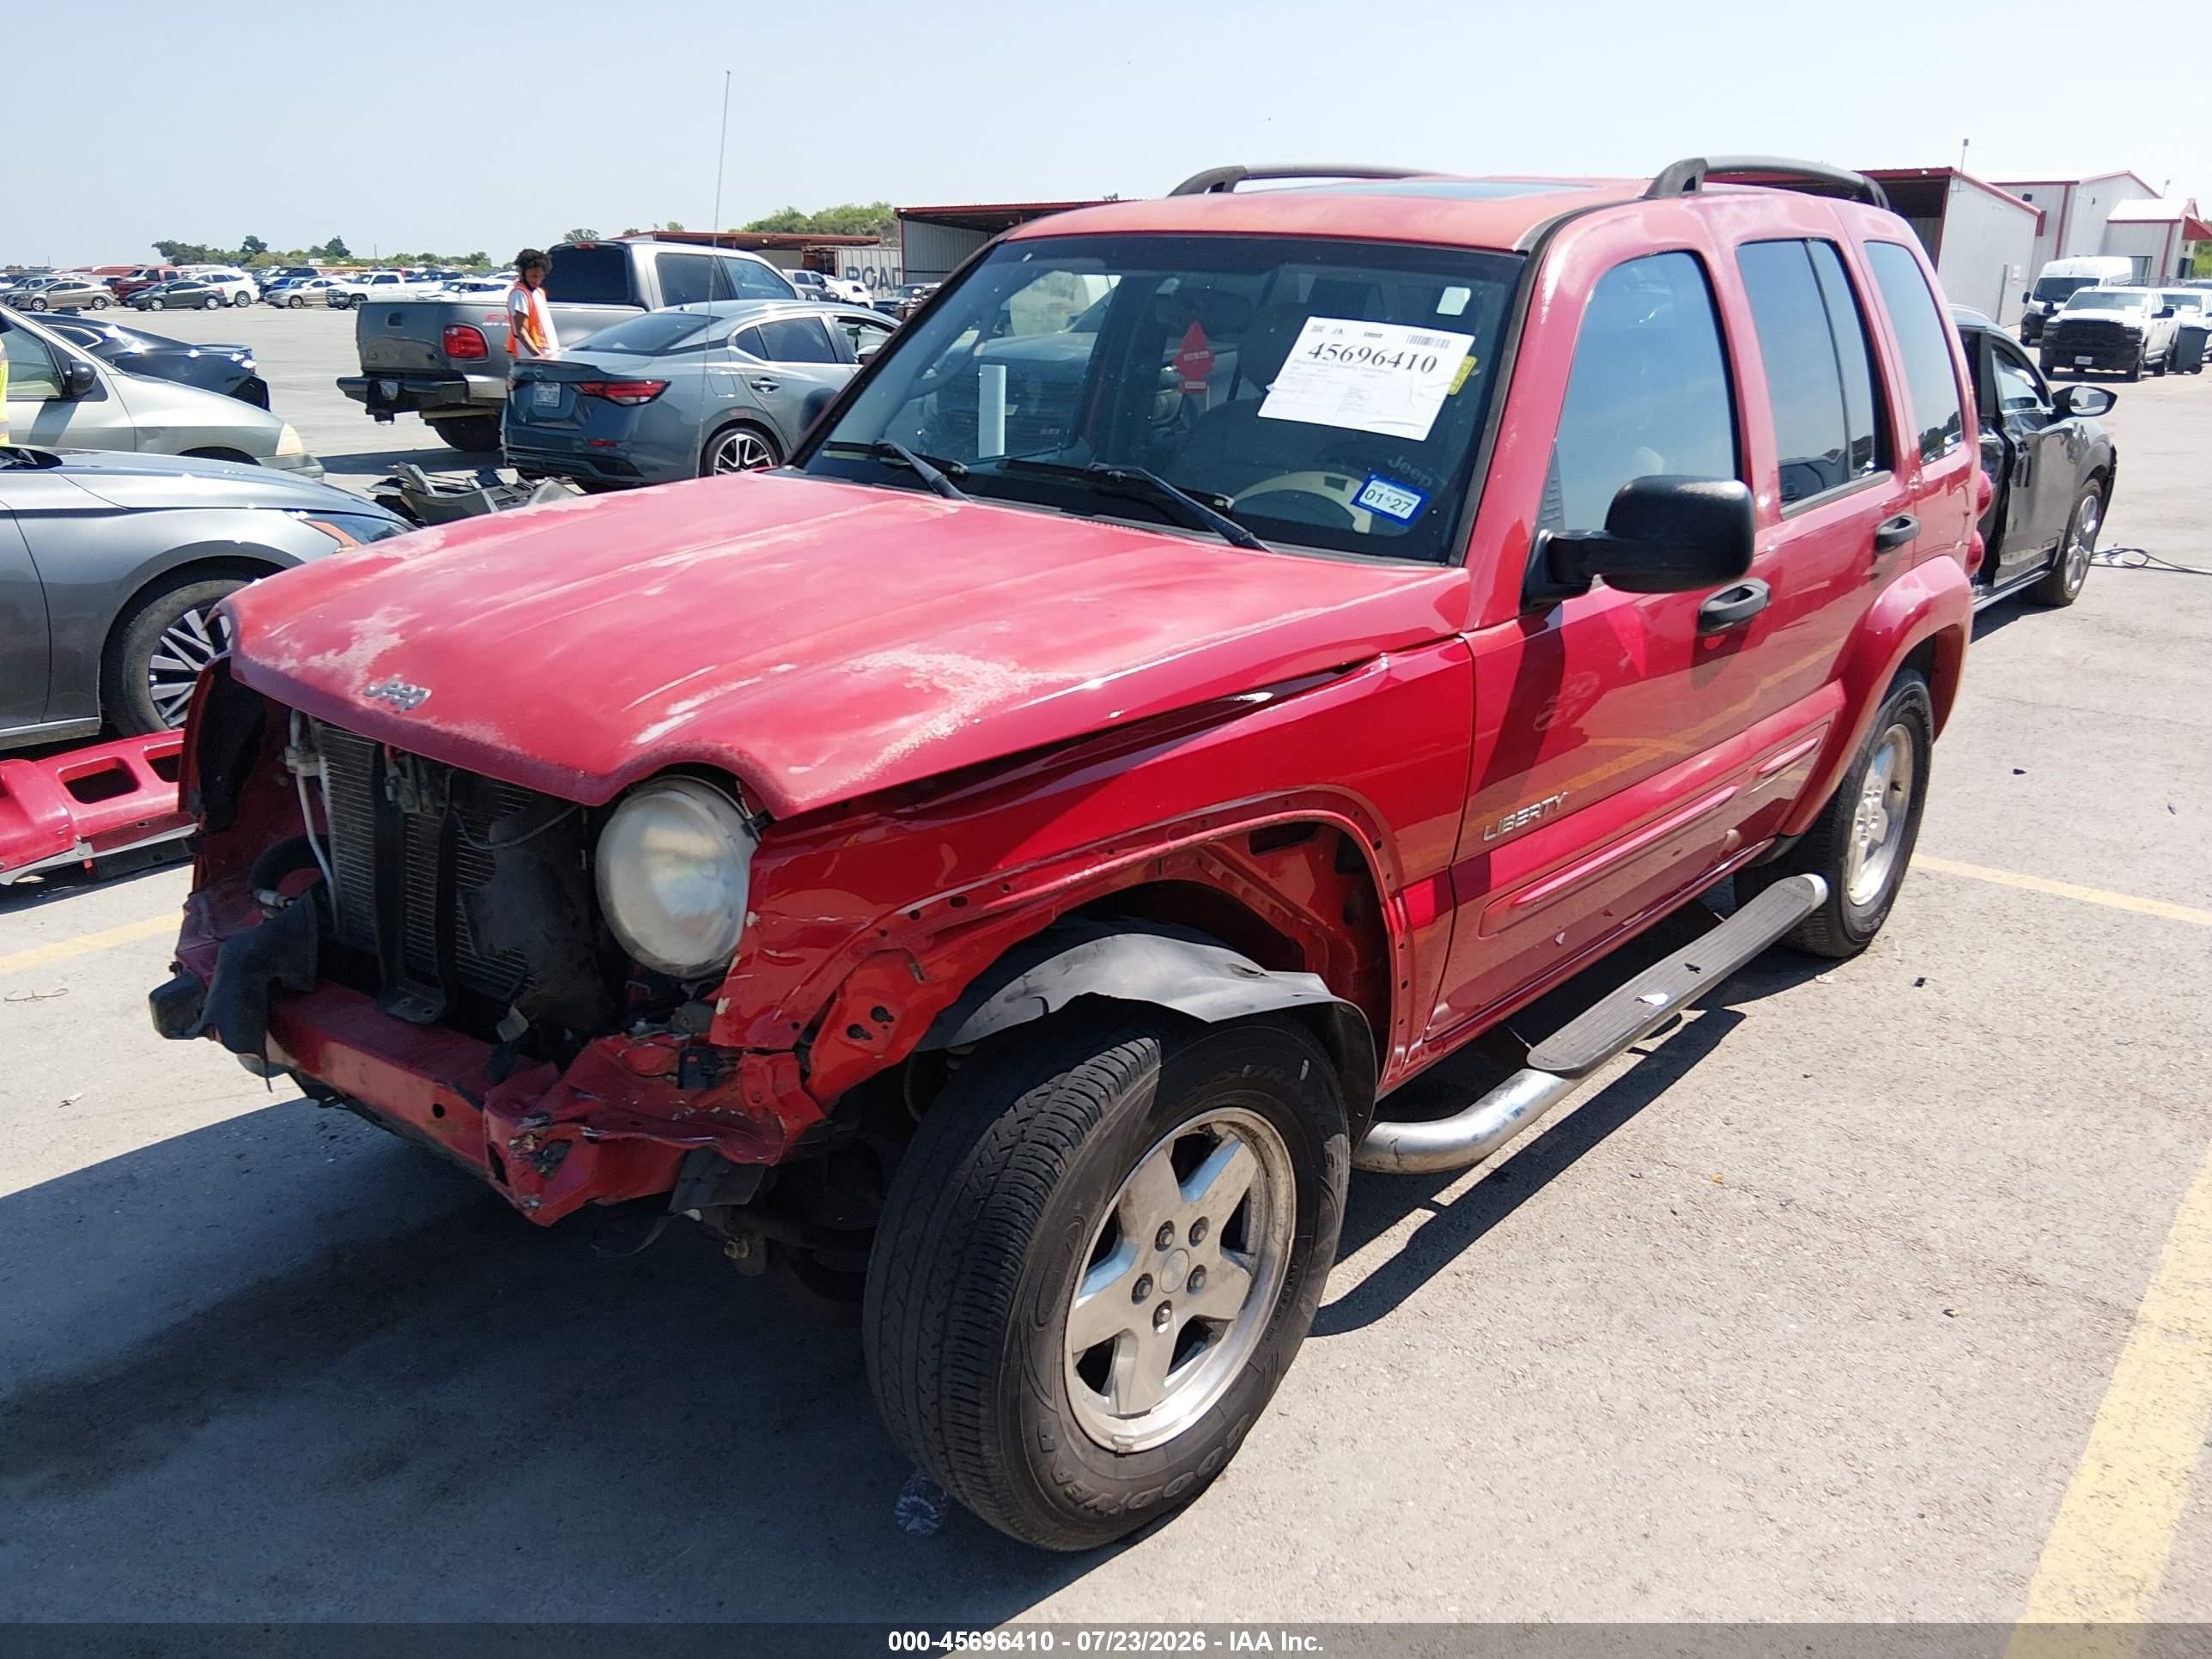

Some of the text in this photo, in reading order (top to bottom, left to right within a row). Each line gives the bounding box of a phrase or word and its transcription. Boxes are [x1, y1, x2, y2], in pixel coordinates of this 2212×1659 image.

[1307, 341, 1438, 374] 45696410
[1387, 455, 1436, 488] Jeep
[1364, 488, 1413, 514] 01 27
[364, 673, 433, 713] Jeep
[1483, 791, 1570, 842] LIBERTY
